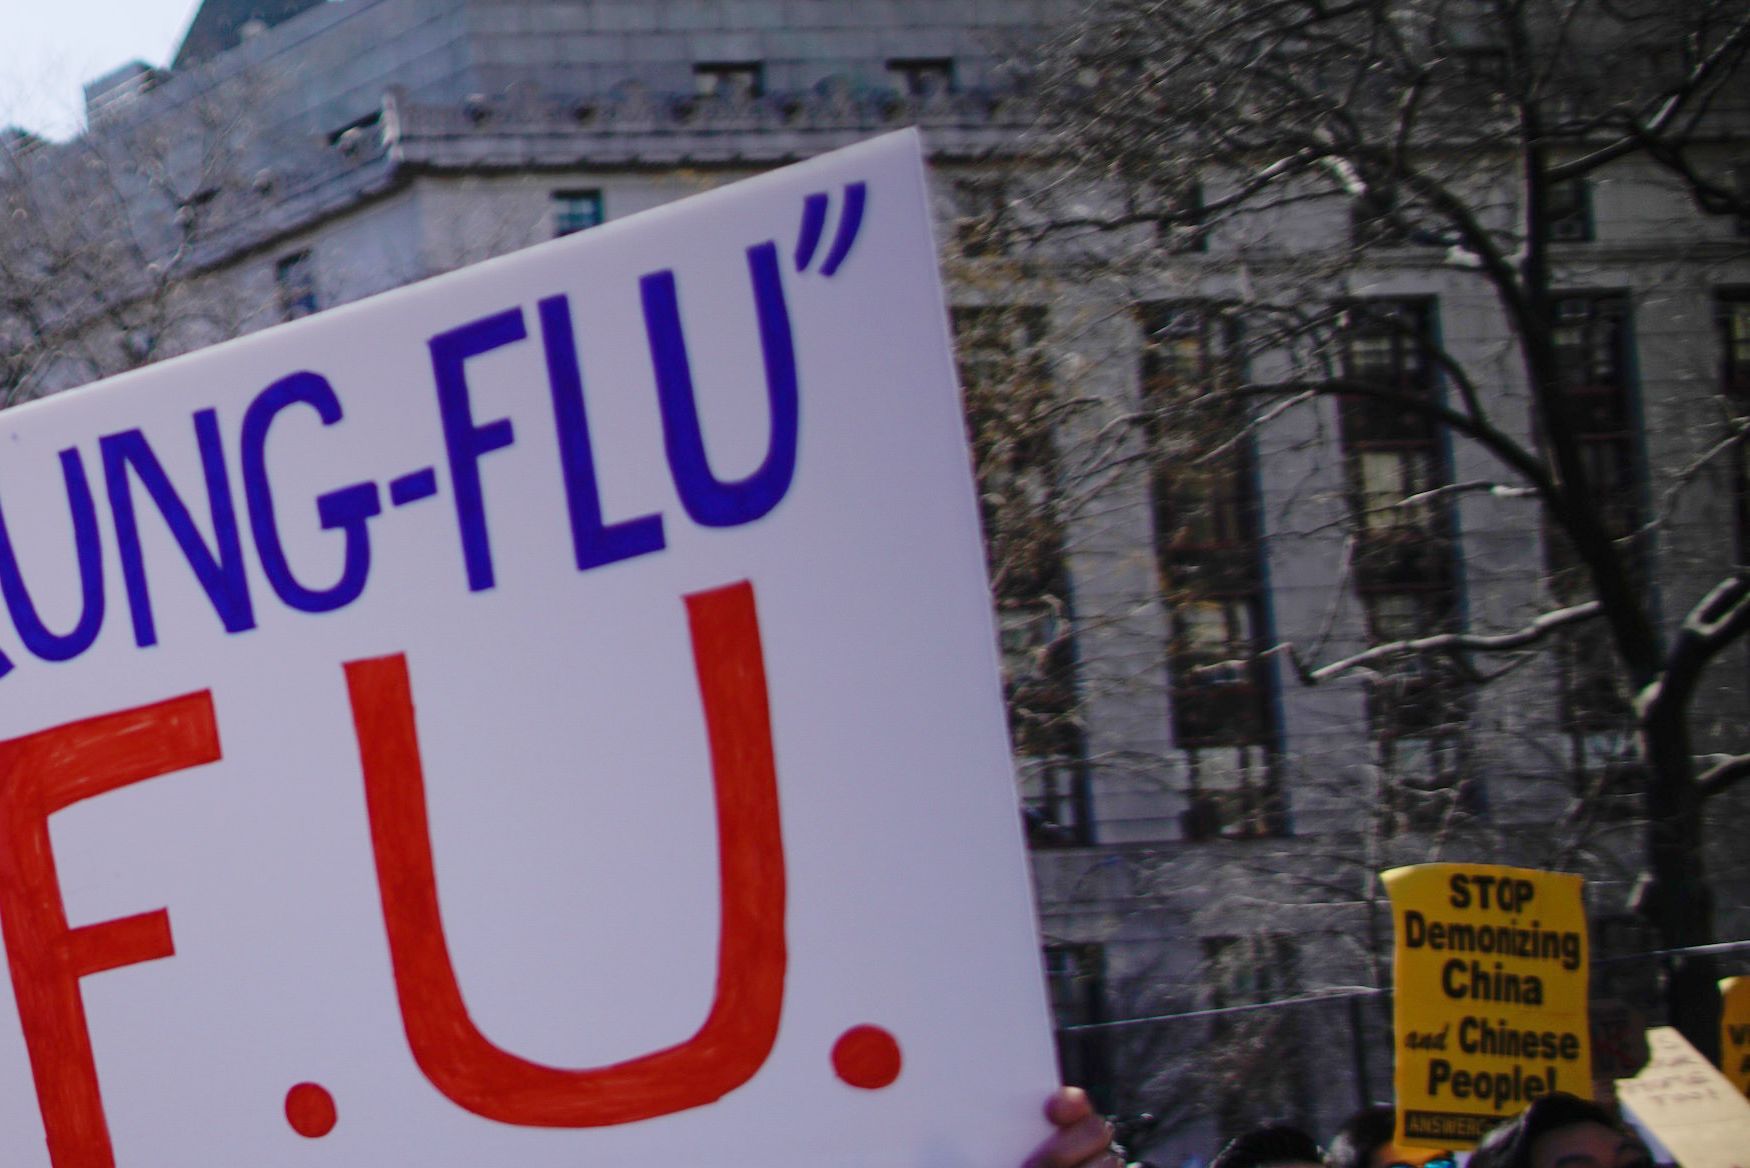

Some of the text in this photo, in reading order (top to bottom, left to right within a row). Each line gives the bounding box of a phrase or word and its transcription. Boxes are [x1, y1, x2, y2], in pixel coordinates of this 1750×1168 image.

[1449, 873, 1534, 914] STOP
[1403, 909, 1581, 972] Demonizing
[1441, 957, 1543, 1006] China
[1403, 1015, 1581, 1062] and Chinese
[1427, 1057, 1557, 1111] People!
